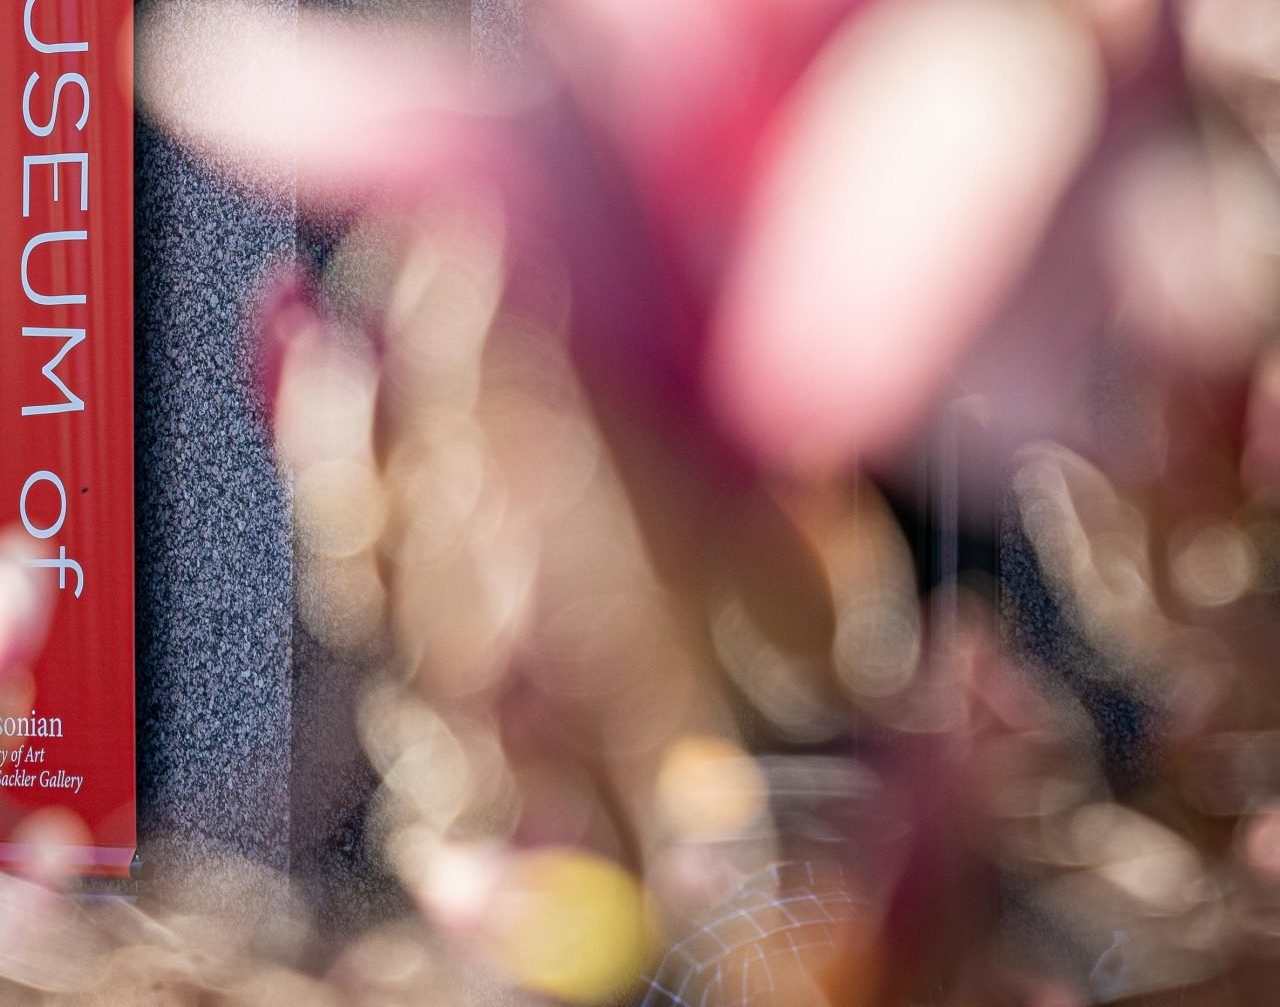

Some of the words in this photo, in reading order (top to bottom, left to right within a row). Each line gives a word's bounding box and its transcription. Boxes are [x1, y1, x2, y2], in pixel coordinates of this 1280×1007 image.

[10, 744, 25, 768] of
[24, 745, 46, 764] Art
[39, 770, 84, 794] Gallery
